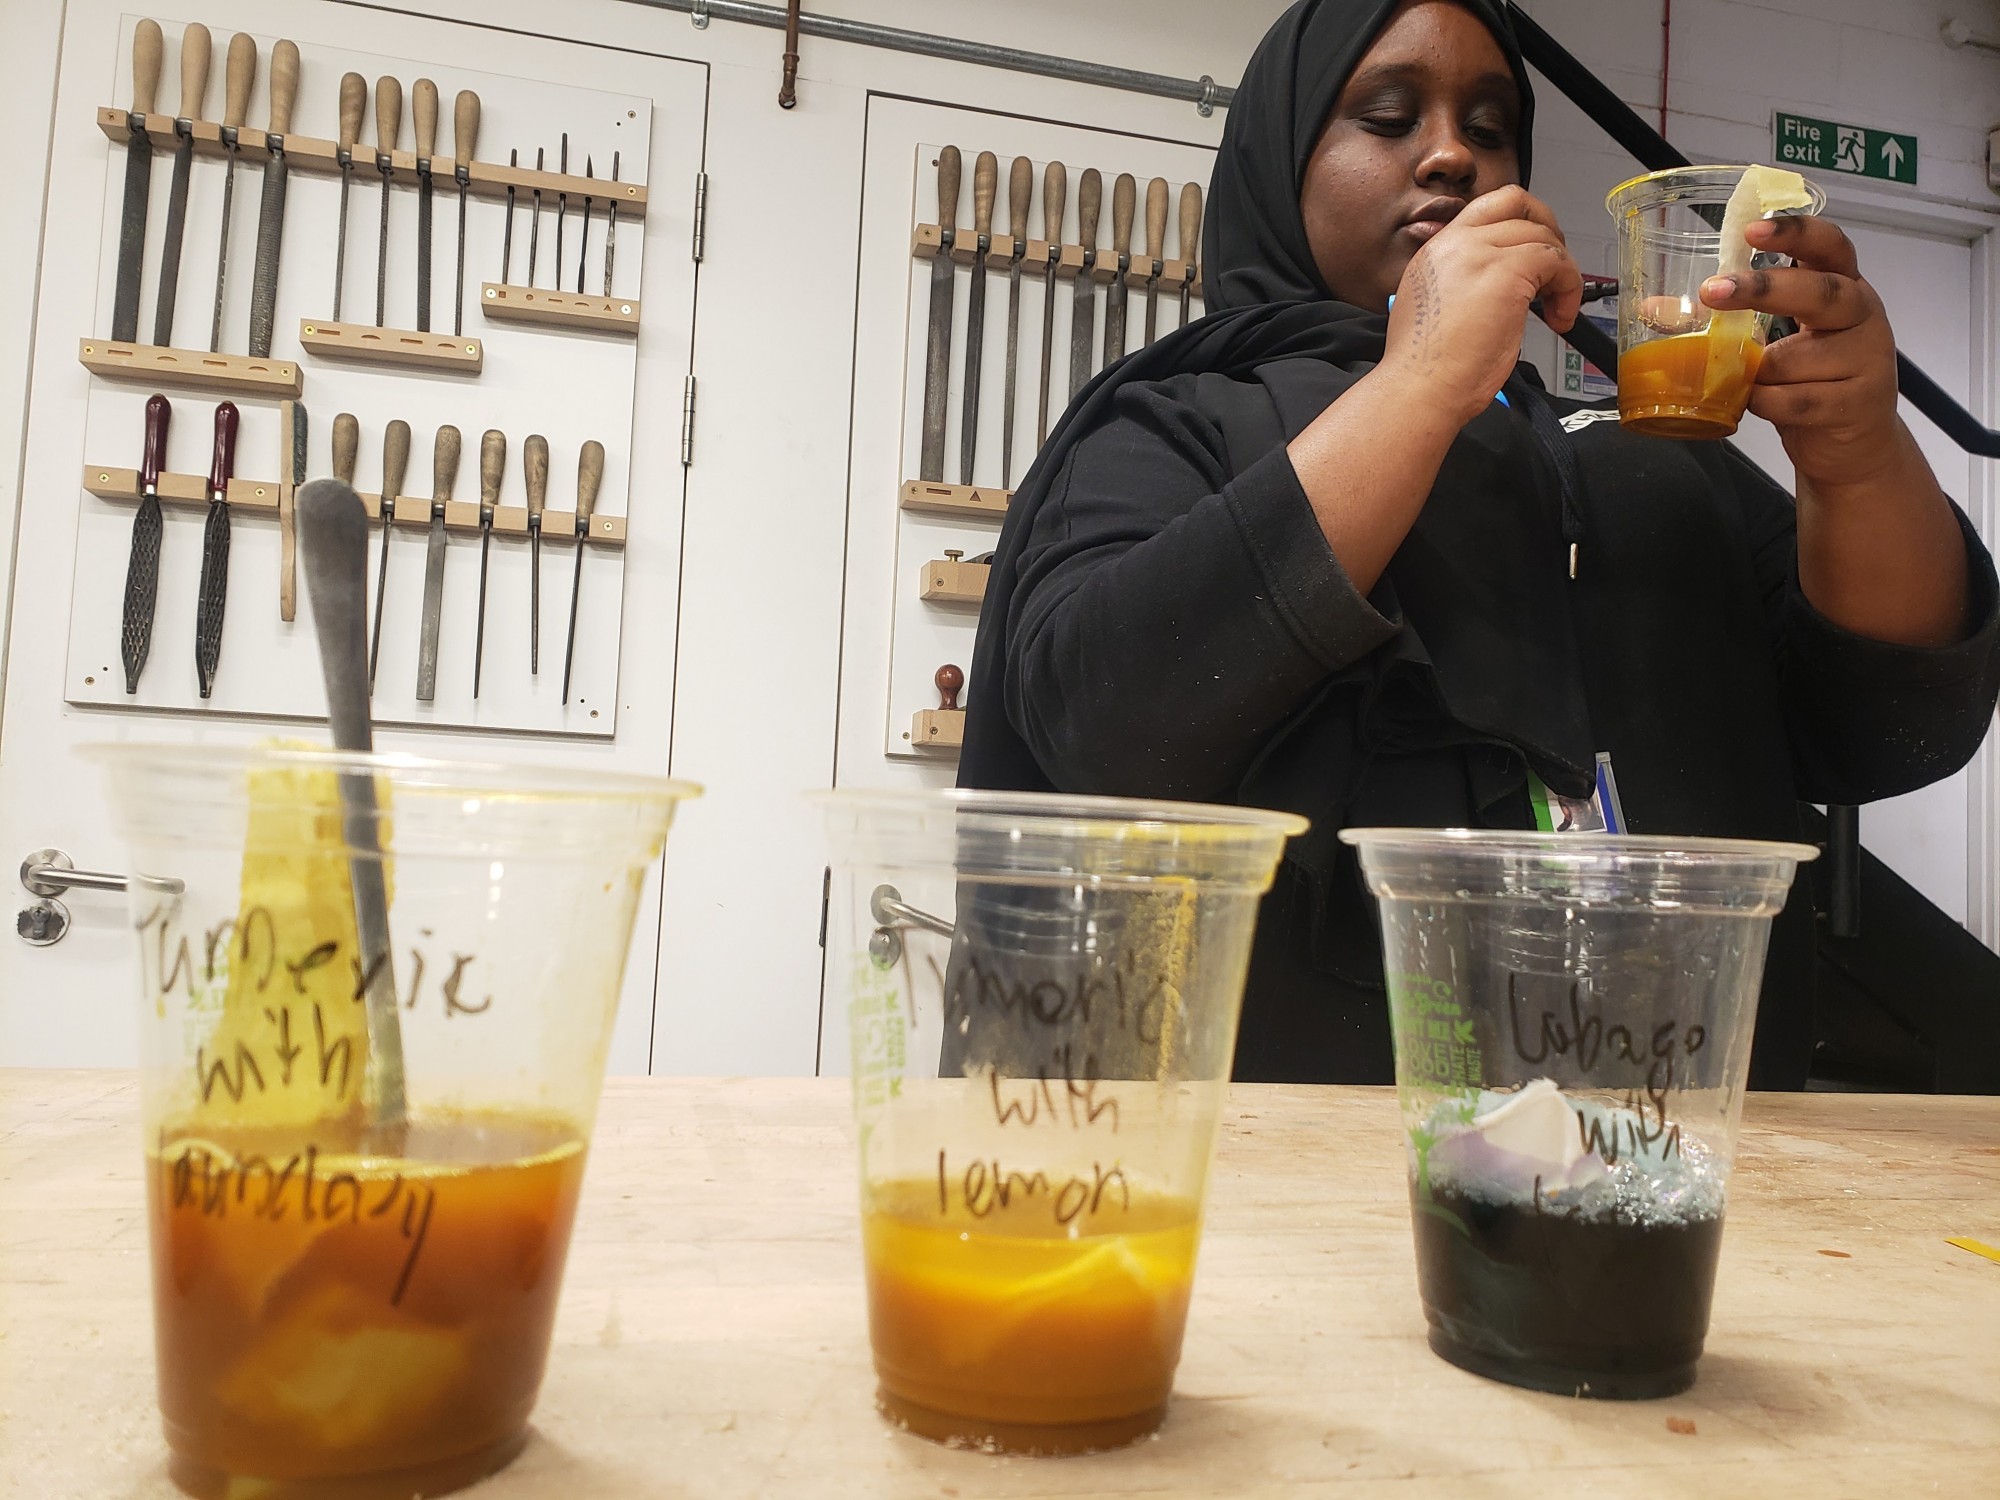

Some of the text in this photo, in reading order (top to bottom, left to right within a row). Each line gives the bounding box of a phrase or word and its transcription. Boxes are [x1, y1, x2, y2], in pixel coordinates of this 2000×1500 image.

[1783, 143, 1821, 164] exit
[1784, 118, 1821, 142] Fire
[196, 1002, 352, 1103] with
[990, 1042, 1120, 1134] with
[938, 1147, 1130, 1227] lemon
